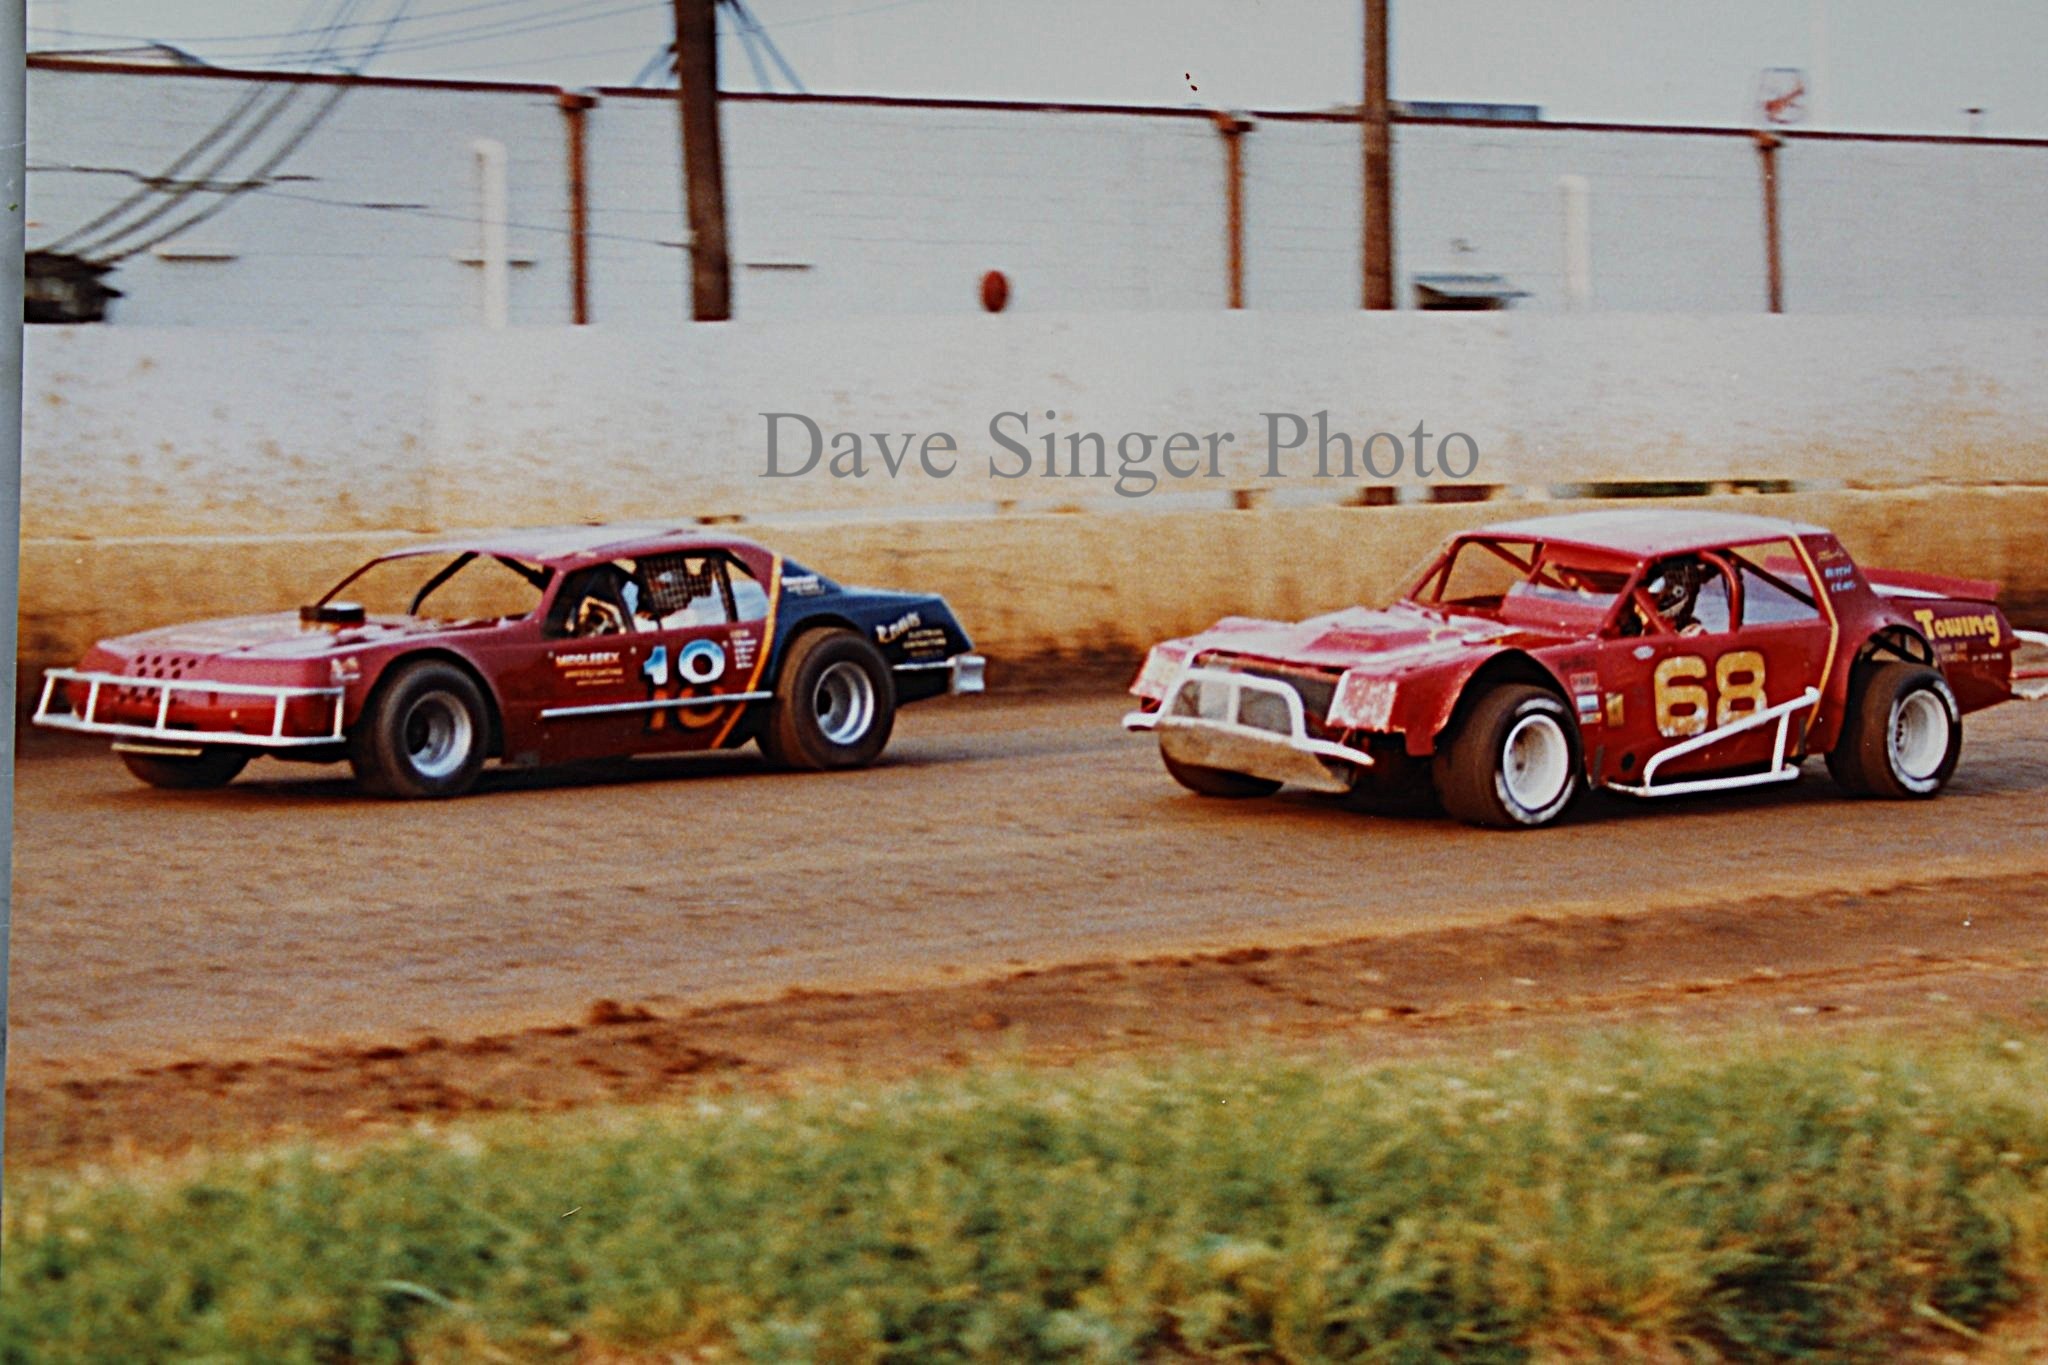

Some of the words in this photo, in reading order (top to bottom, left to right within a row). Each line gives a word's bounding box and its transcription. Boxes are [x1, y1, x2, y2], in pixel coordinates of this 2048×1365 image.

[1913, 608, 2001, 648] Towing
[643, 638, 726, 685] 10
[1653, 650, 1768, 738] 68
